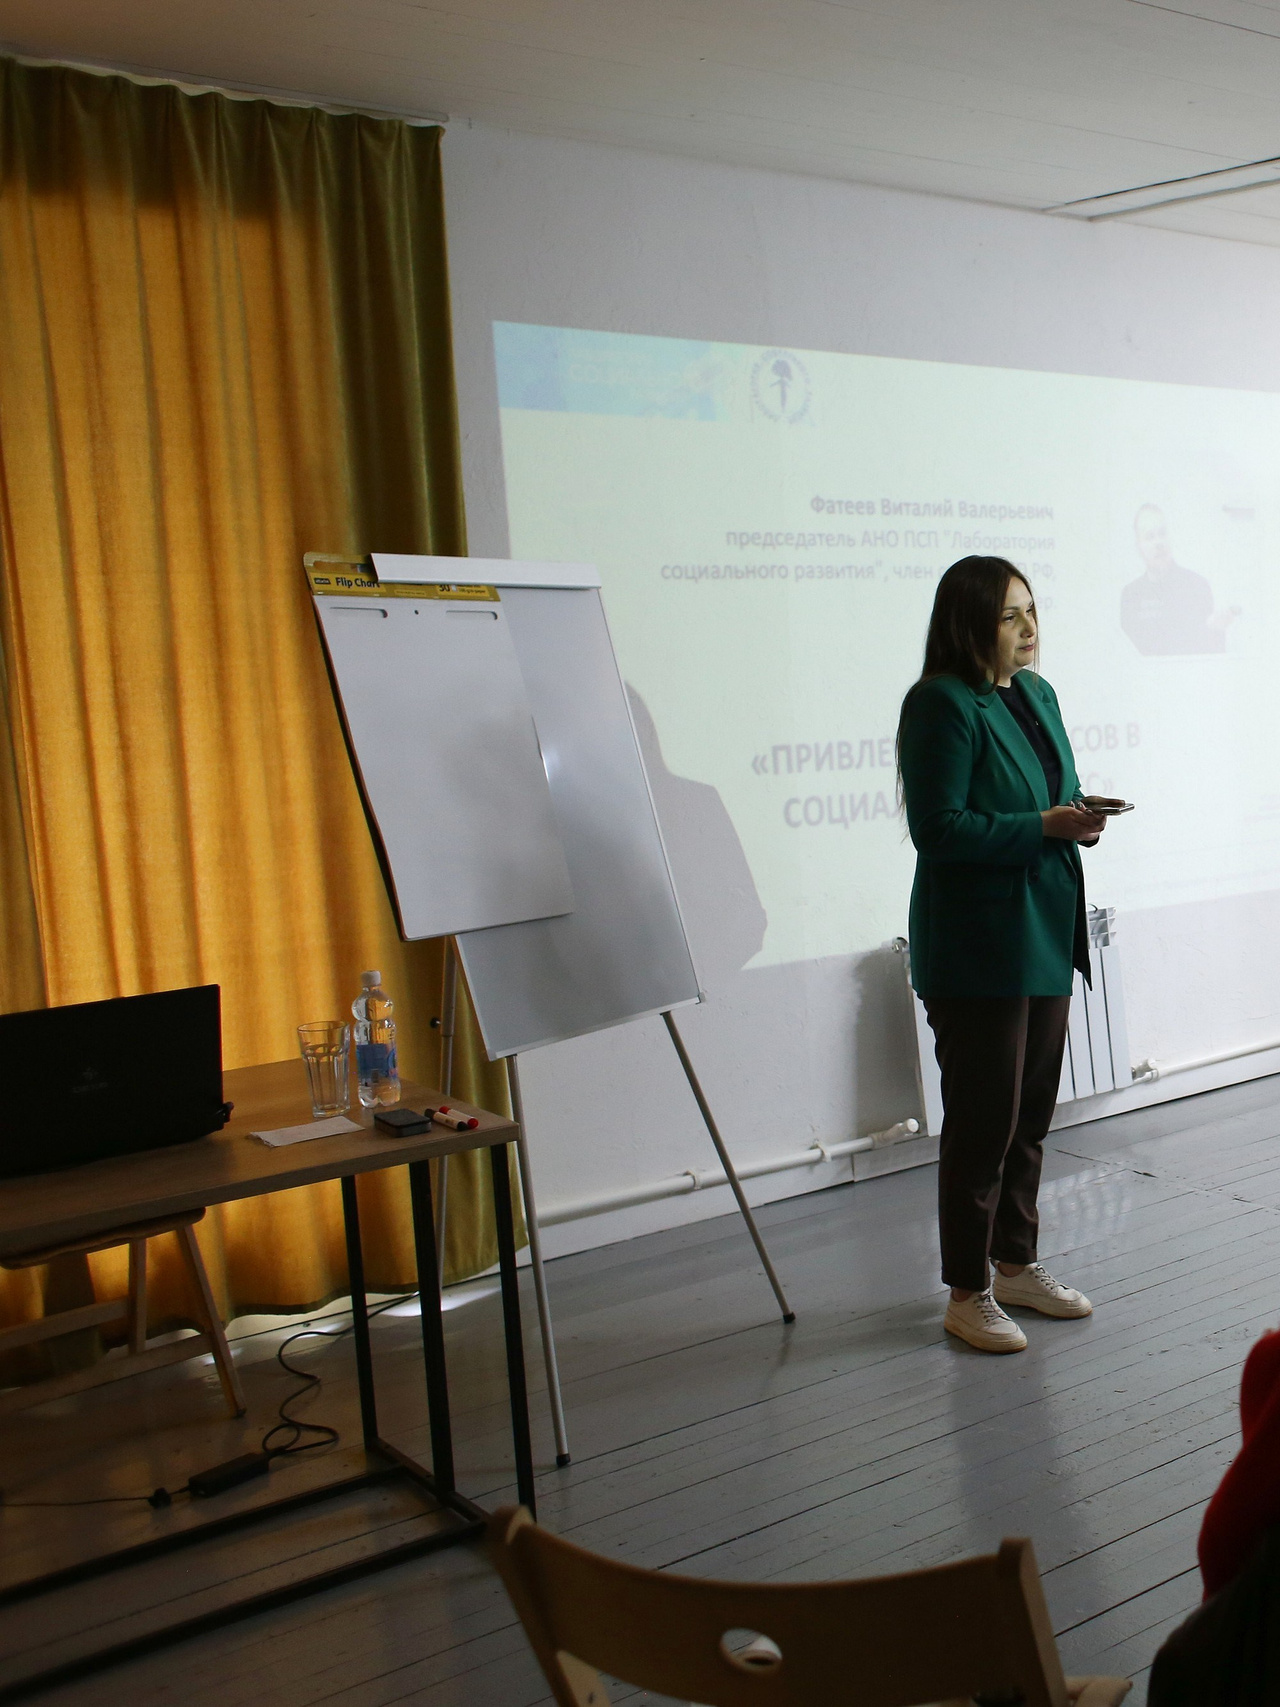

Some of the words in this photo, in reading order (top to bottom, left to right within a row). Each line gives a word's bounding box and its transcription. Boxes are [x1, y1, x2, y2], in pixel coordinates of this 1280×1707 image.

[810, 496, 875, 516] Фатеев
[881, 497, 953, 518] Виталий
[958, 500, 1053, 520] Валерьевич
[726, 530, 855, 551] председатель
[861, 530, 898, 548] АНО
[903, 530, 938, 548] ПСП
[944, 530, 1054, 551] "Лаборатория
[335, 577, 353, 588] Flip
[354, 578, 380, 588] Chart
[661, 563, 788, 583] социального
[794, 561, 888, 582] развития",
[893, 565, 932, 579] член
[751, 737, 893, 775] «ПРИВЛЕ
